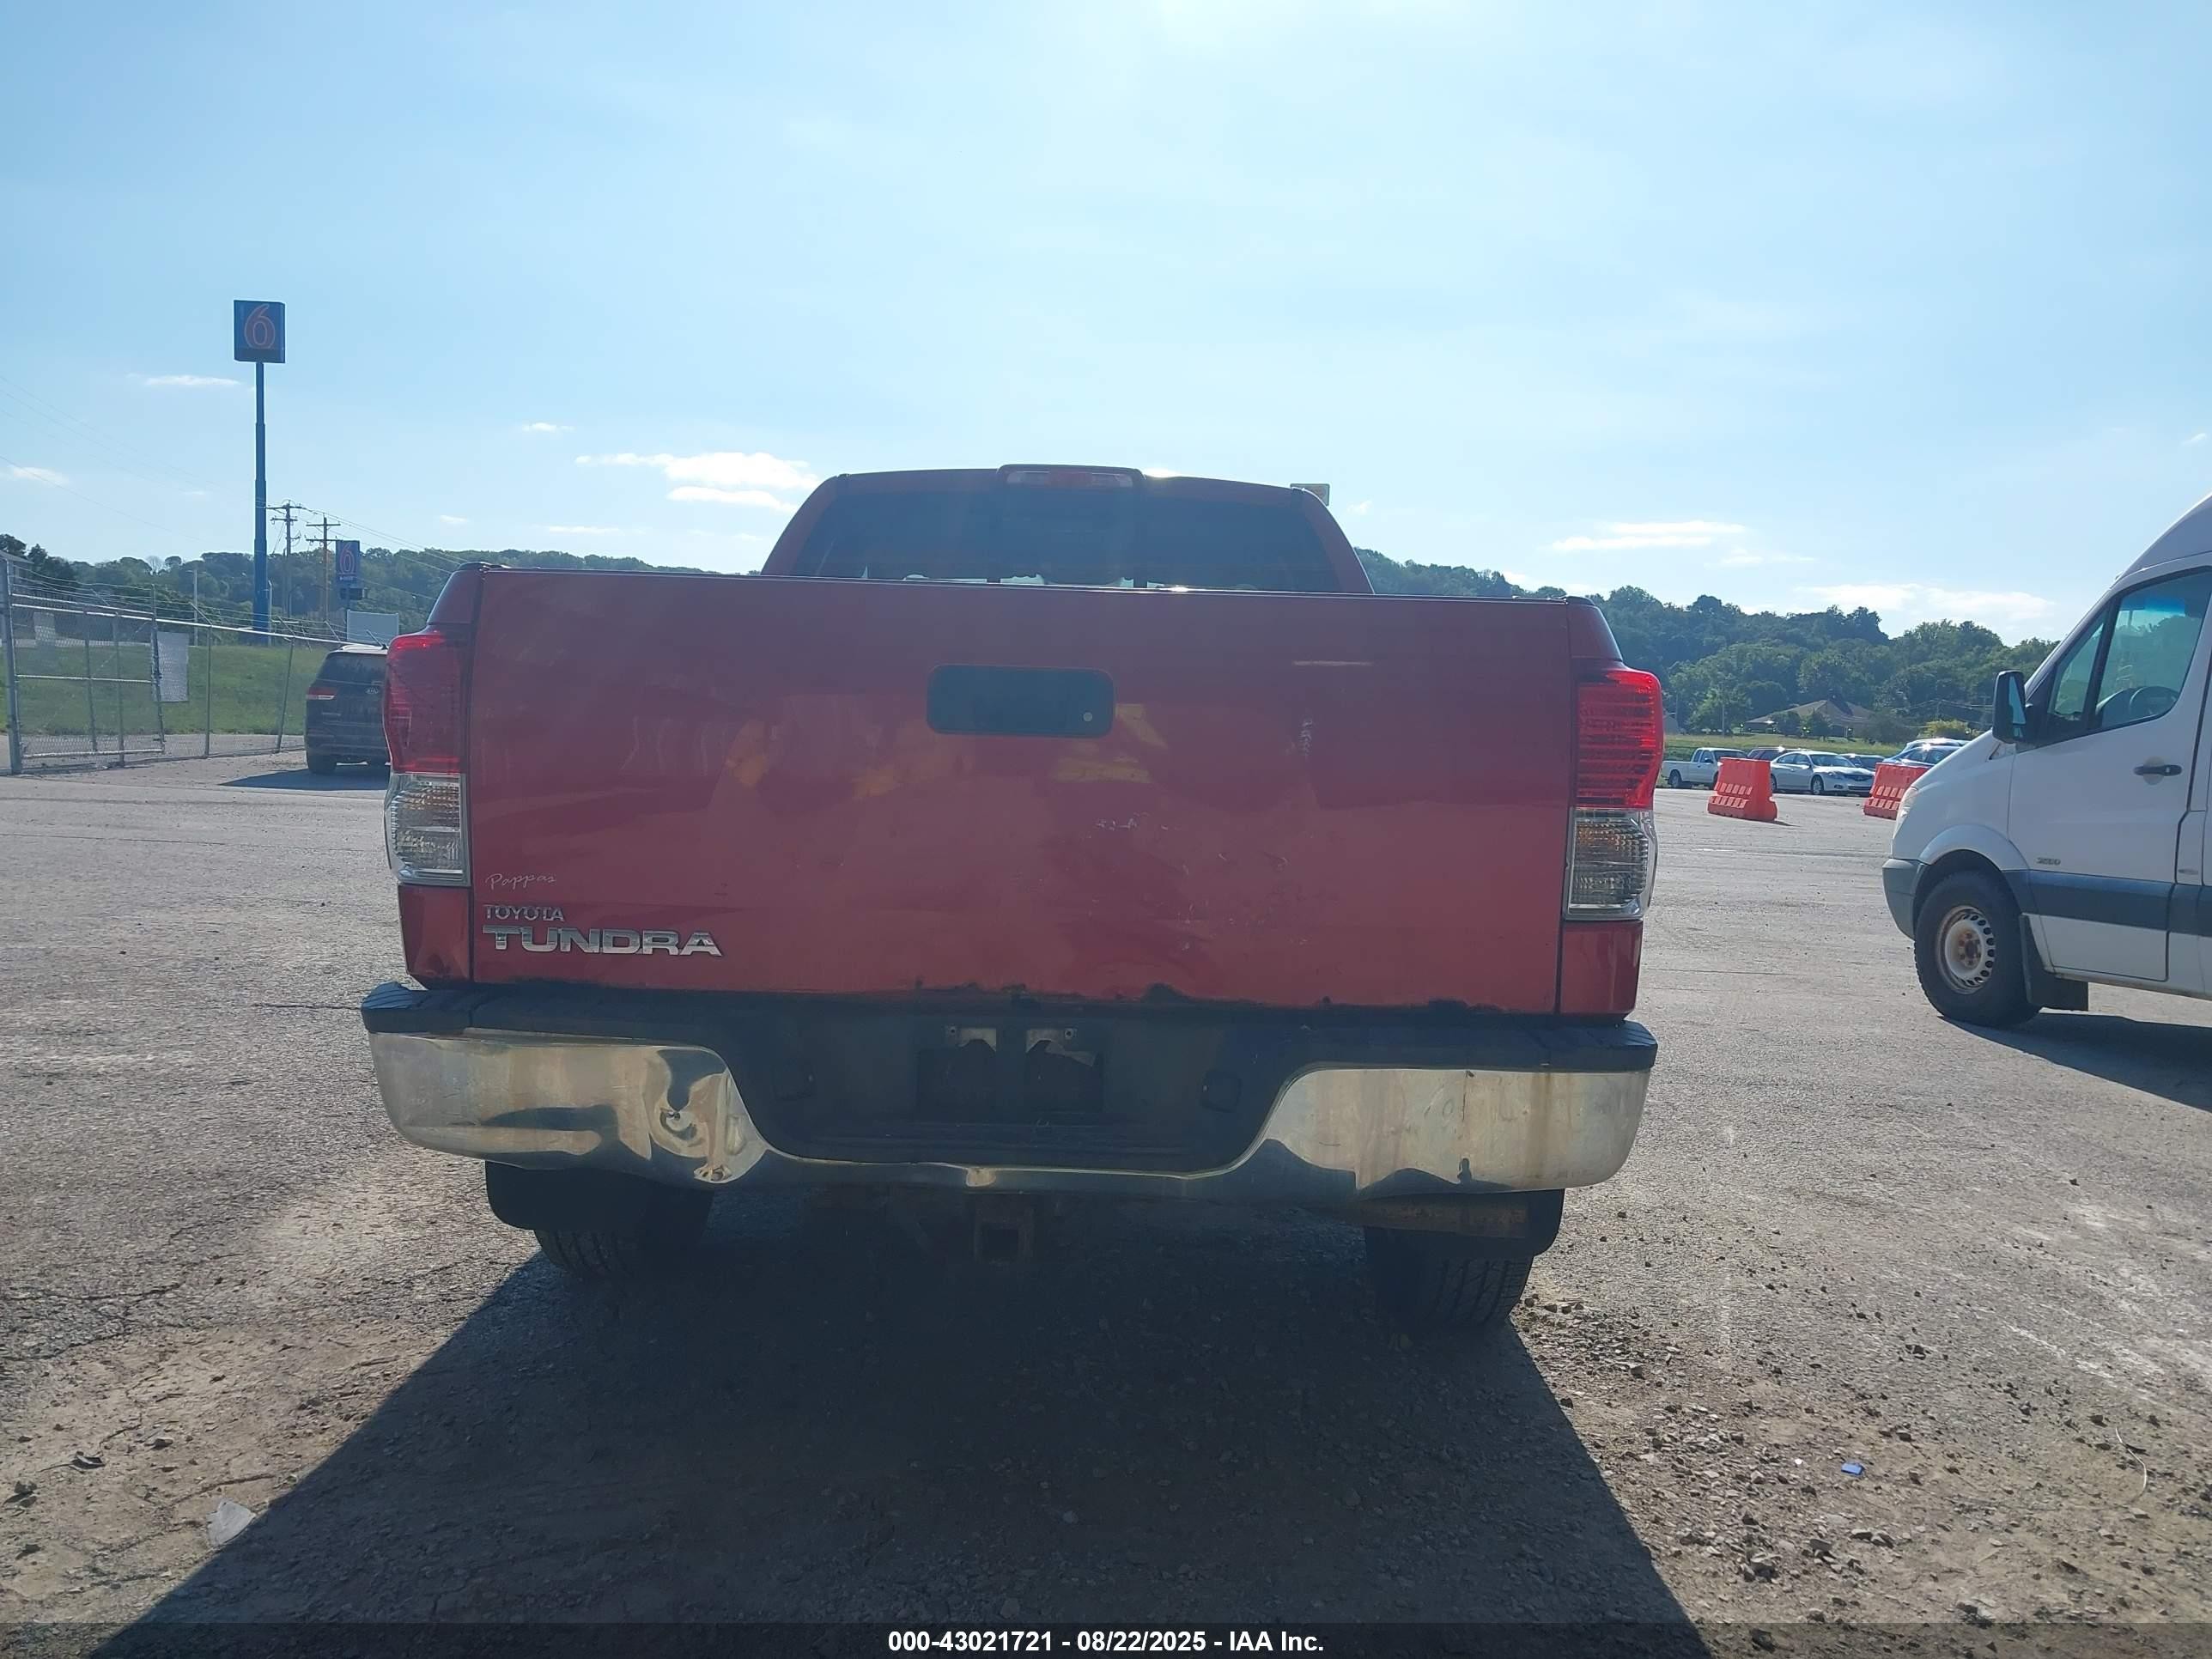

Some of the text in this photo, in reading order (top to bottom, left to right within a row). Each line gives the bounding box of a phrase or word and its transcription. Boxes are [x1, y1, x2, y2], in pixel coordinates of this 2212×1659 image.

[244, 303, 276, 349] 6
[339, 542, 355, 574] 6
[483, 904, 565, 921] TOYOTA
[483, 925, 722, 957] TUNDRA
